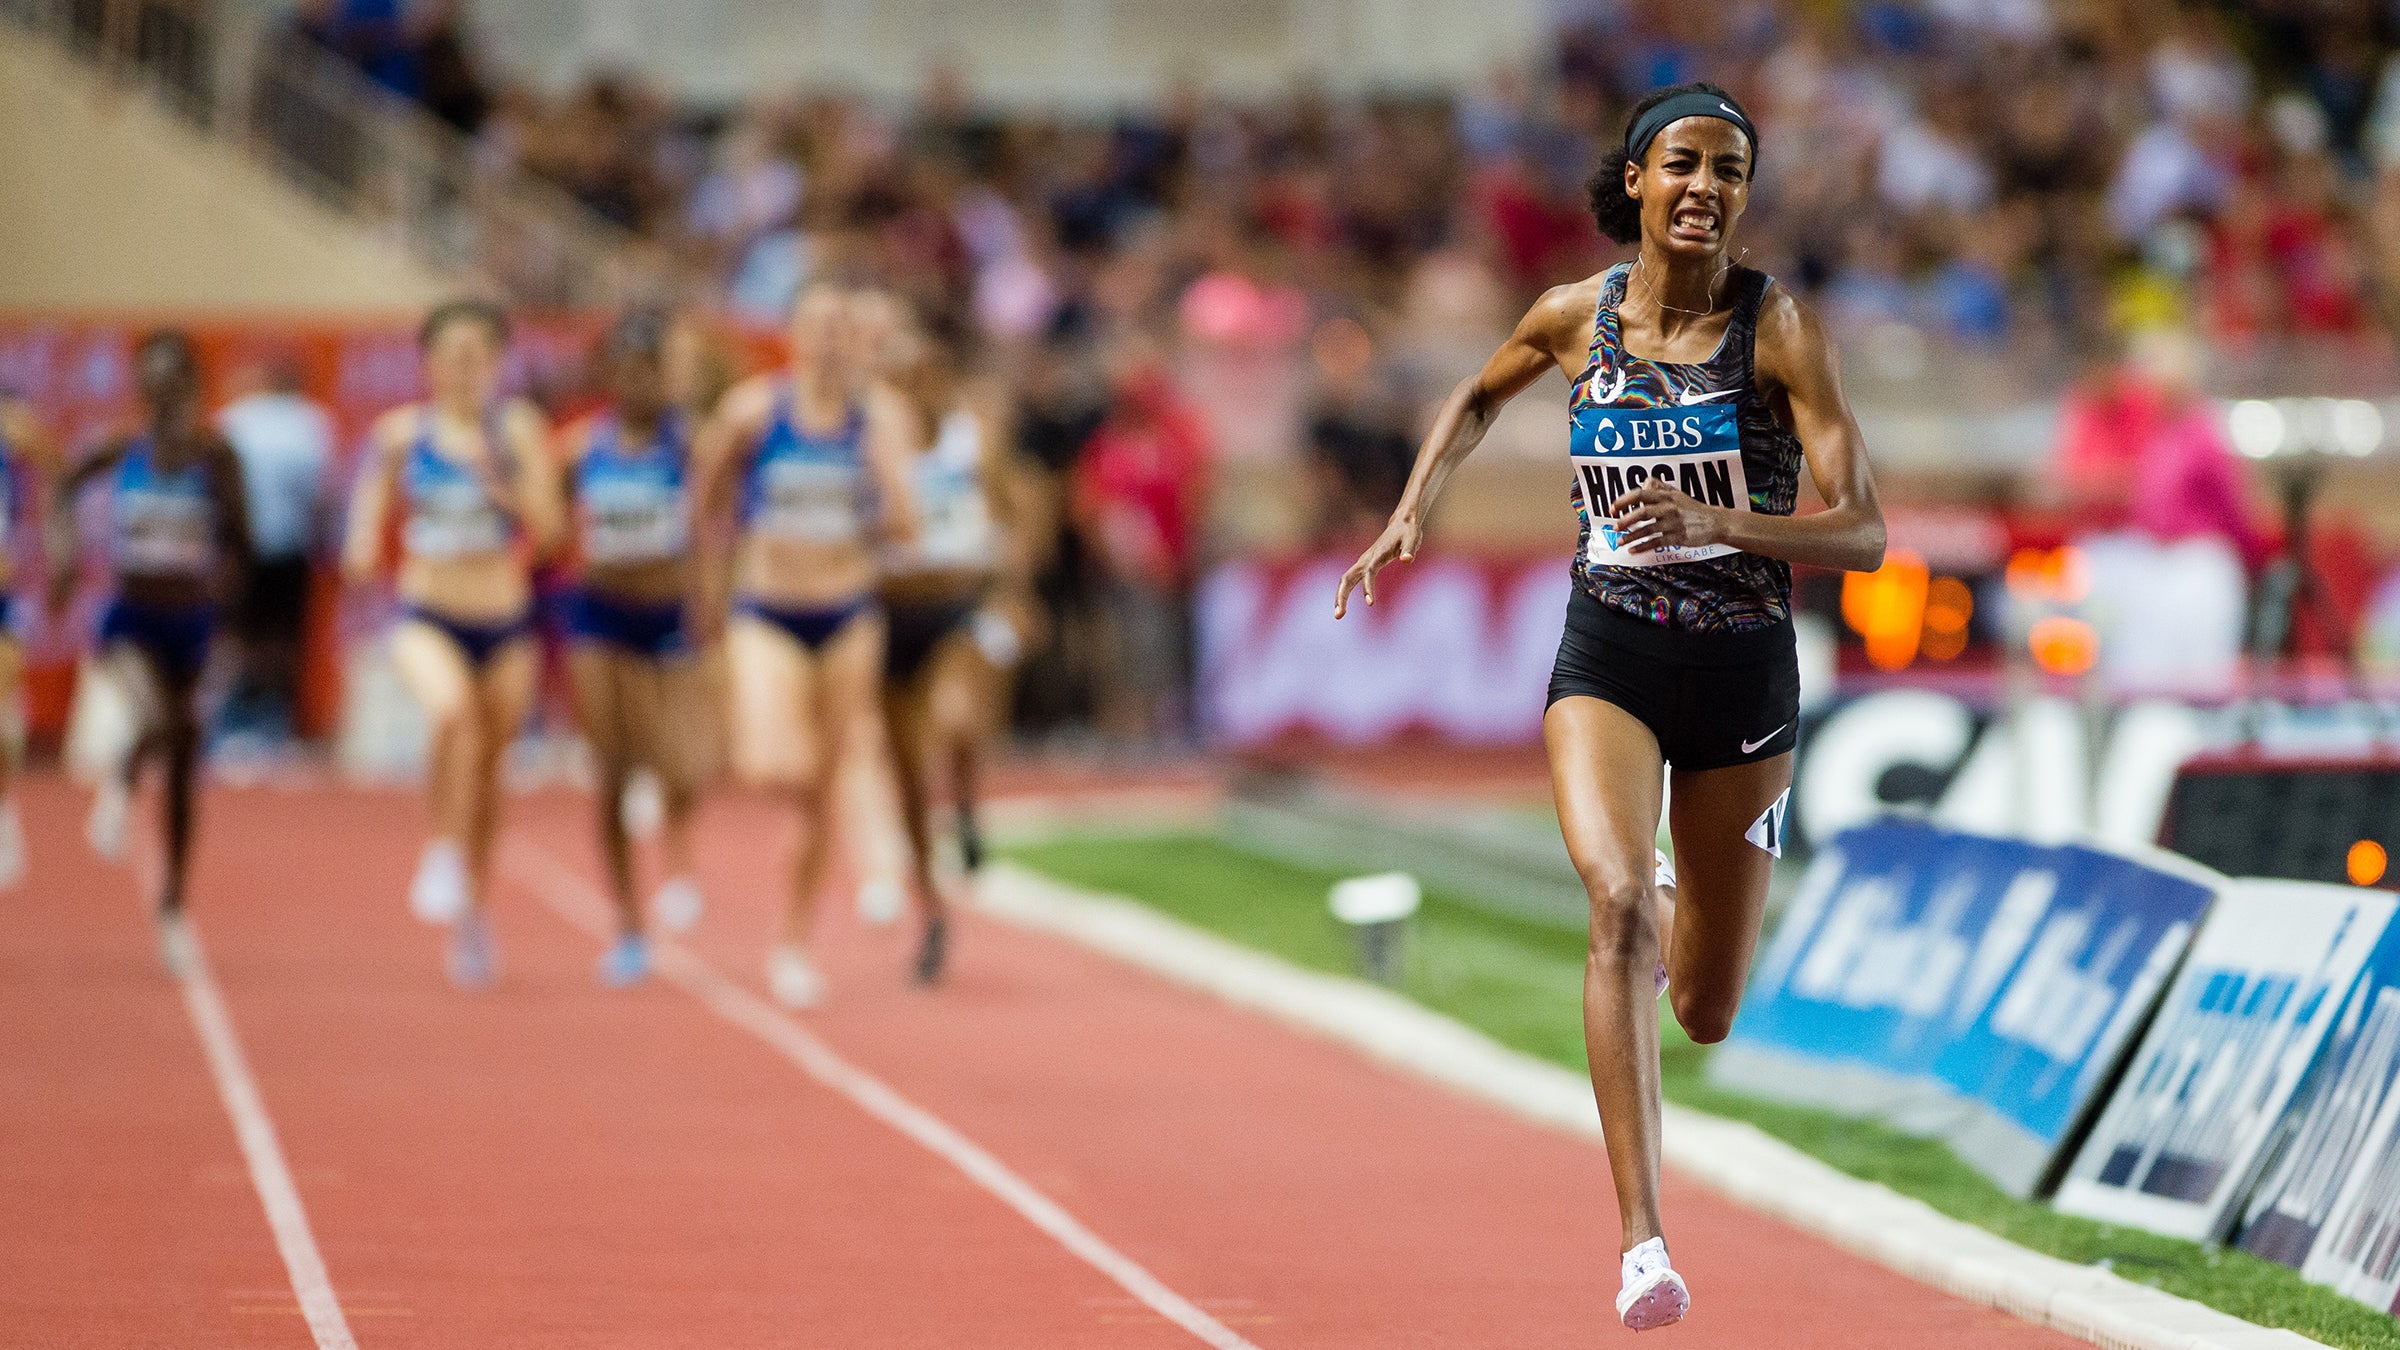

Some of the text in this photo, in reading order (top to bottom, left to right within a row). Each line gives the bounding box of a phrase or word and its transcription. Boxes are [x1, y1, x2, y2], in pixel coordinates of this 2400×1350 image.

[1629, 417, 1703, 450] EBS
[1655, 552, 1681, 562] LIKE
[1684, 545, 1715, 559] GABE
